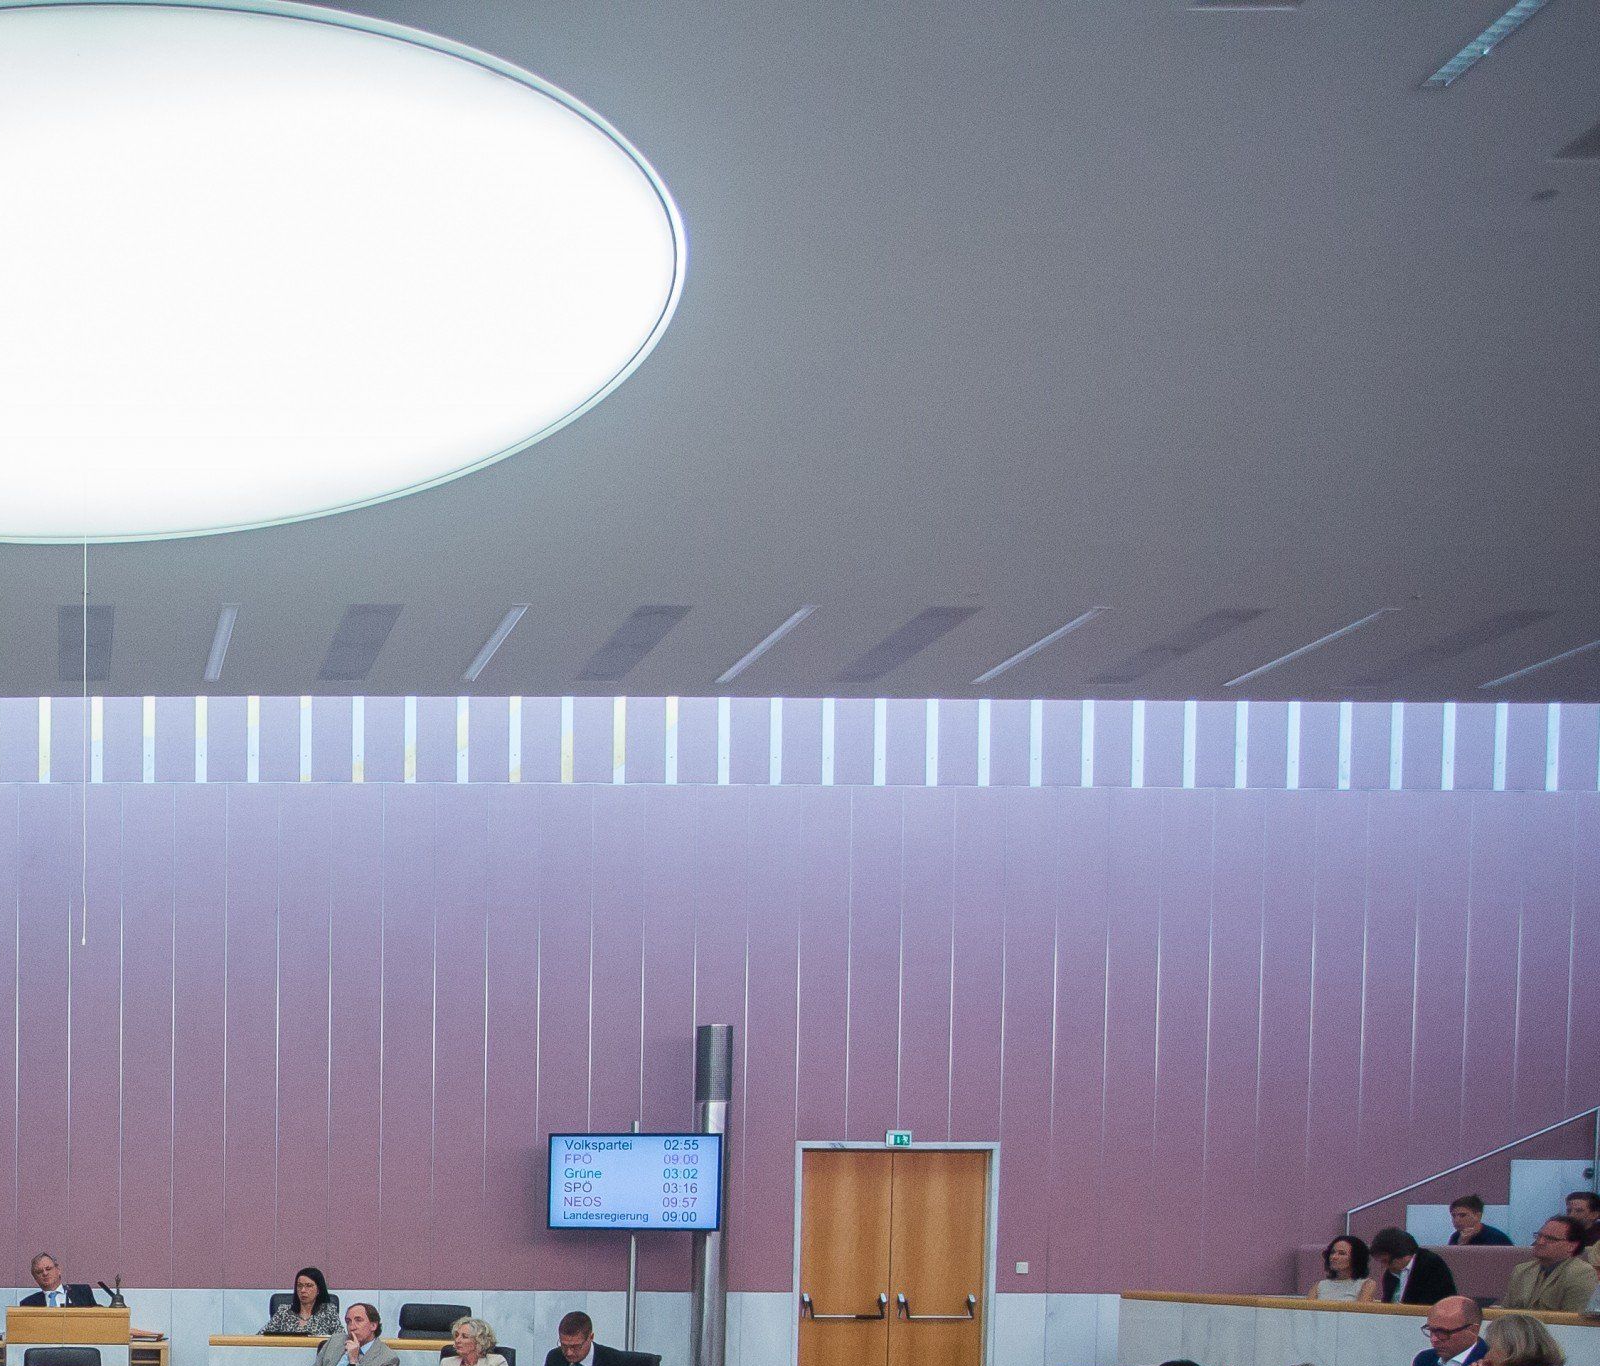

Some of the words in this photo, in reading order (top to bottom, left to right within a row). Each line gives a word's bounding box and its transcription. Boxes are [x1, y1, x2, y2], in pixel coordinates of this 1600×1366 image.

[564, 1139, 633, 1152] Volkspartei
[663, 1139, 699, 1151] 02:55
[564, 1152, 592, 1165] FPÖ
[663, 1153, 699, 1165] 09:00
[564, 1167, 602, 1179] Grüne
[662, 1168, 698, 1180] 03:02
[563, 1180, 593, 1193] SPÖ
[662, 1182, 698, 1194] 03:16
[563, 1196, 602, 1207] NEOS
[662, 1196, 698, 1208] 09:57
[563, 1211, 649, 1222] Landesregierung
[661, 1211, 697, 1223] 09:00
